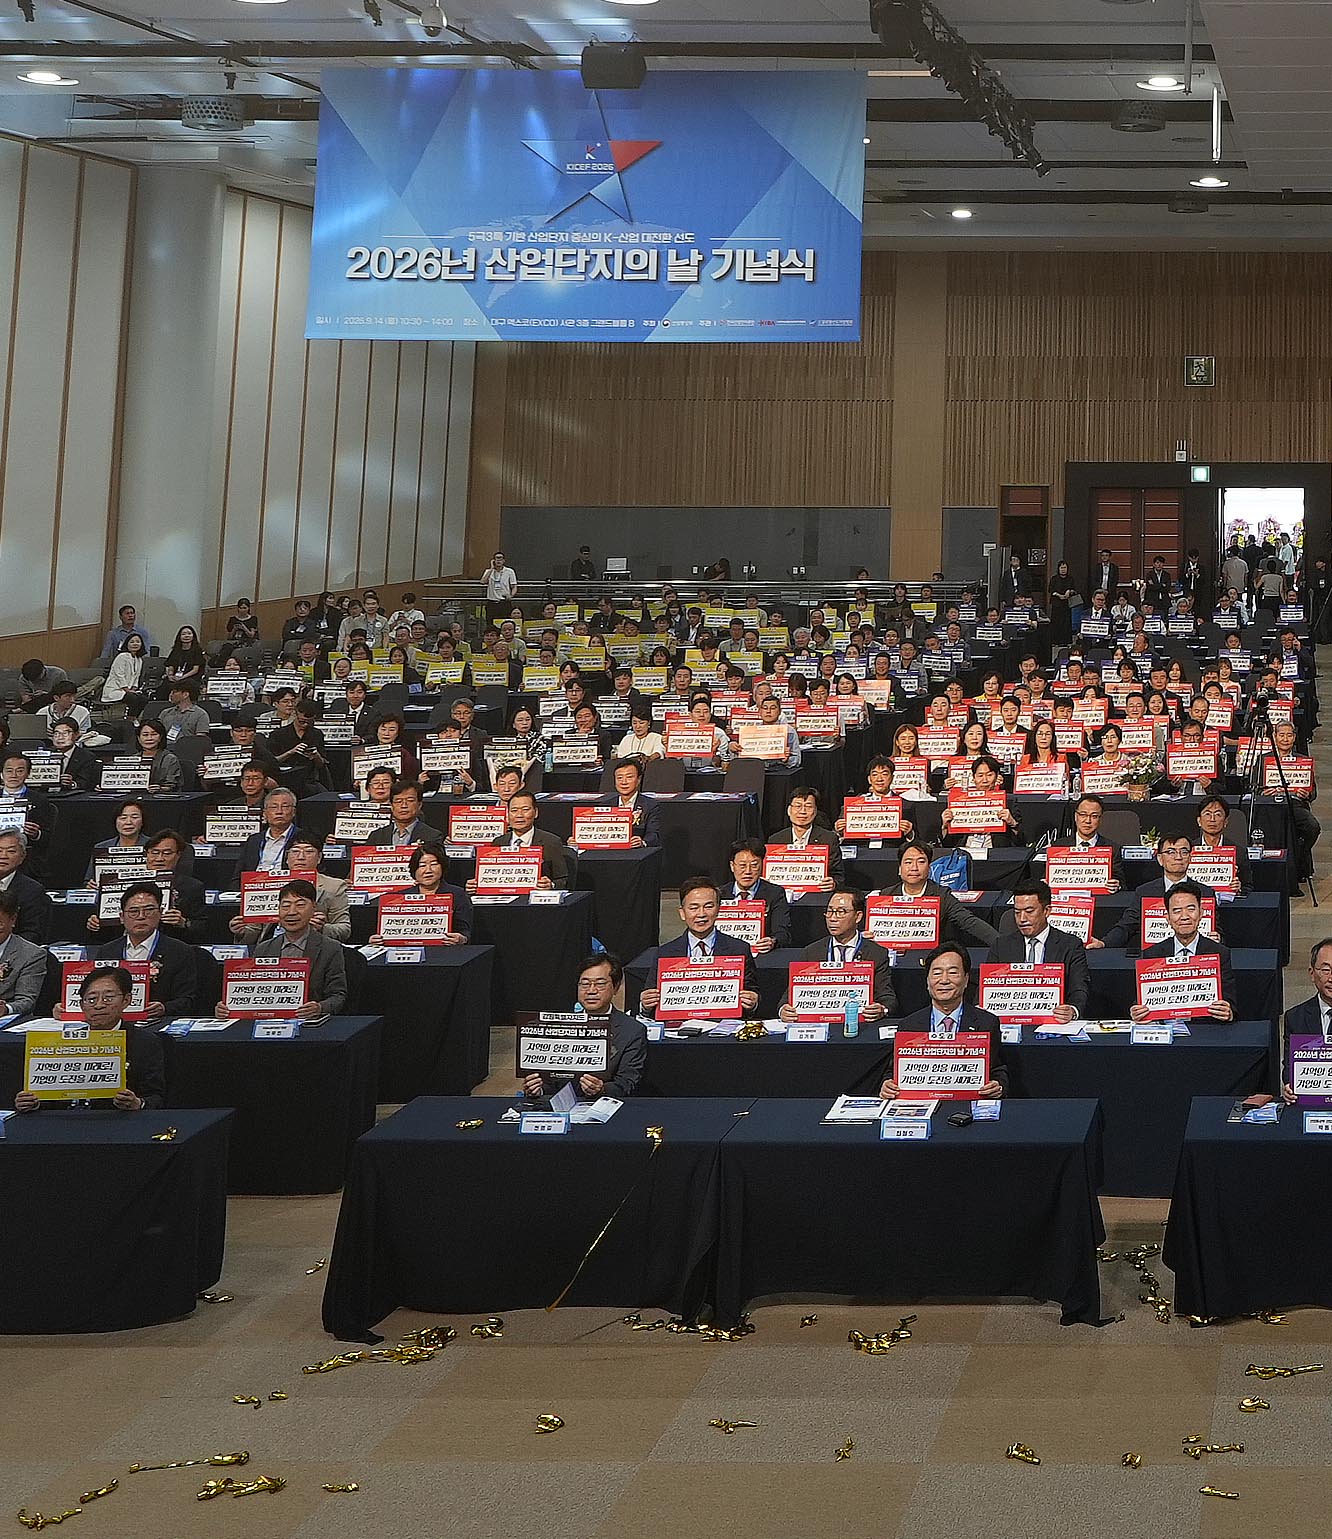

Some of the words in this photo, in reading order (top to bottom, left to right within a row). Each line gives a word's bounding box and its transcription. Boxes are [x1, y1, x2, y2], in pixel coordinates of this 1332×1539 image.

[505, 232, 526, 242] 기반
[528, 233, 569, 243] 산업단지
[571, 233, 601, 243] 중심의
[604, 233, 640, 243] K-산업
[642, 233, 672, 243] 대전환
[674, 233, 695, 243] 선도
[346, 246, 475, 280] 2026년
[485, 248, 658, 281] 산업단지의
[667, 249, 703, 282] 날
[711, 249, 815, 282] 기념식
[520, 1027, 544, 1035] 2026년
[545, 1028, 577, 1036] 산업단지의
[56, 1046, 90, 1054] 산업단지의
[526, 1042, 551, 1052] 지역의
[522, 1054, 547, 1064] 기업의
[1293, 1051, 1318, 1059] 2026년
[35, 1062, 61, 1071] 지역의
[904, 1063, 930, 1072] 지역의
[1300, 1067, 1325, 1076] 지역의
[30, 1075, 57, 1084] 기업의
[901, 1075, 925, 1084] 기업의
[1296, 1080, 1322, 1088] 기업의
